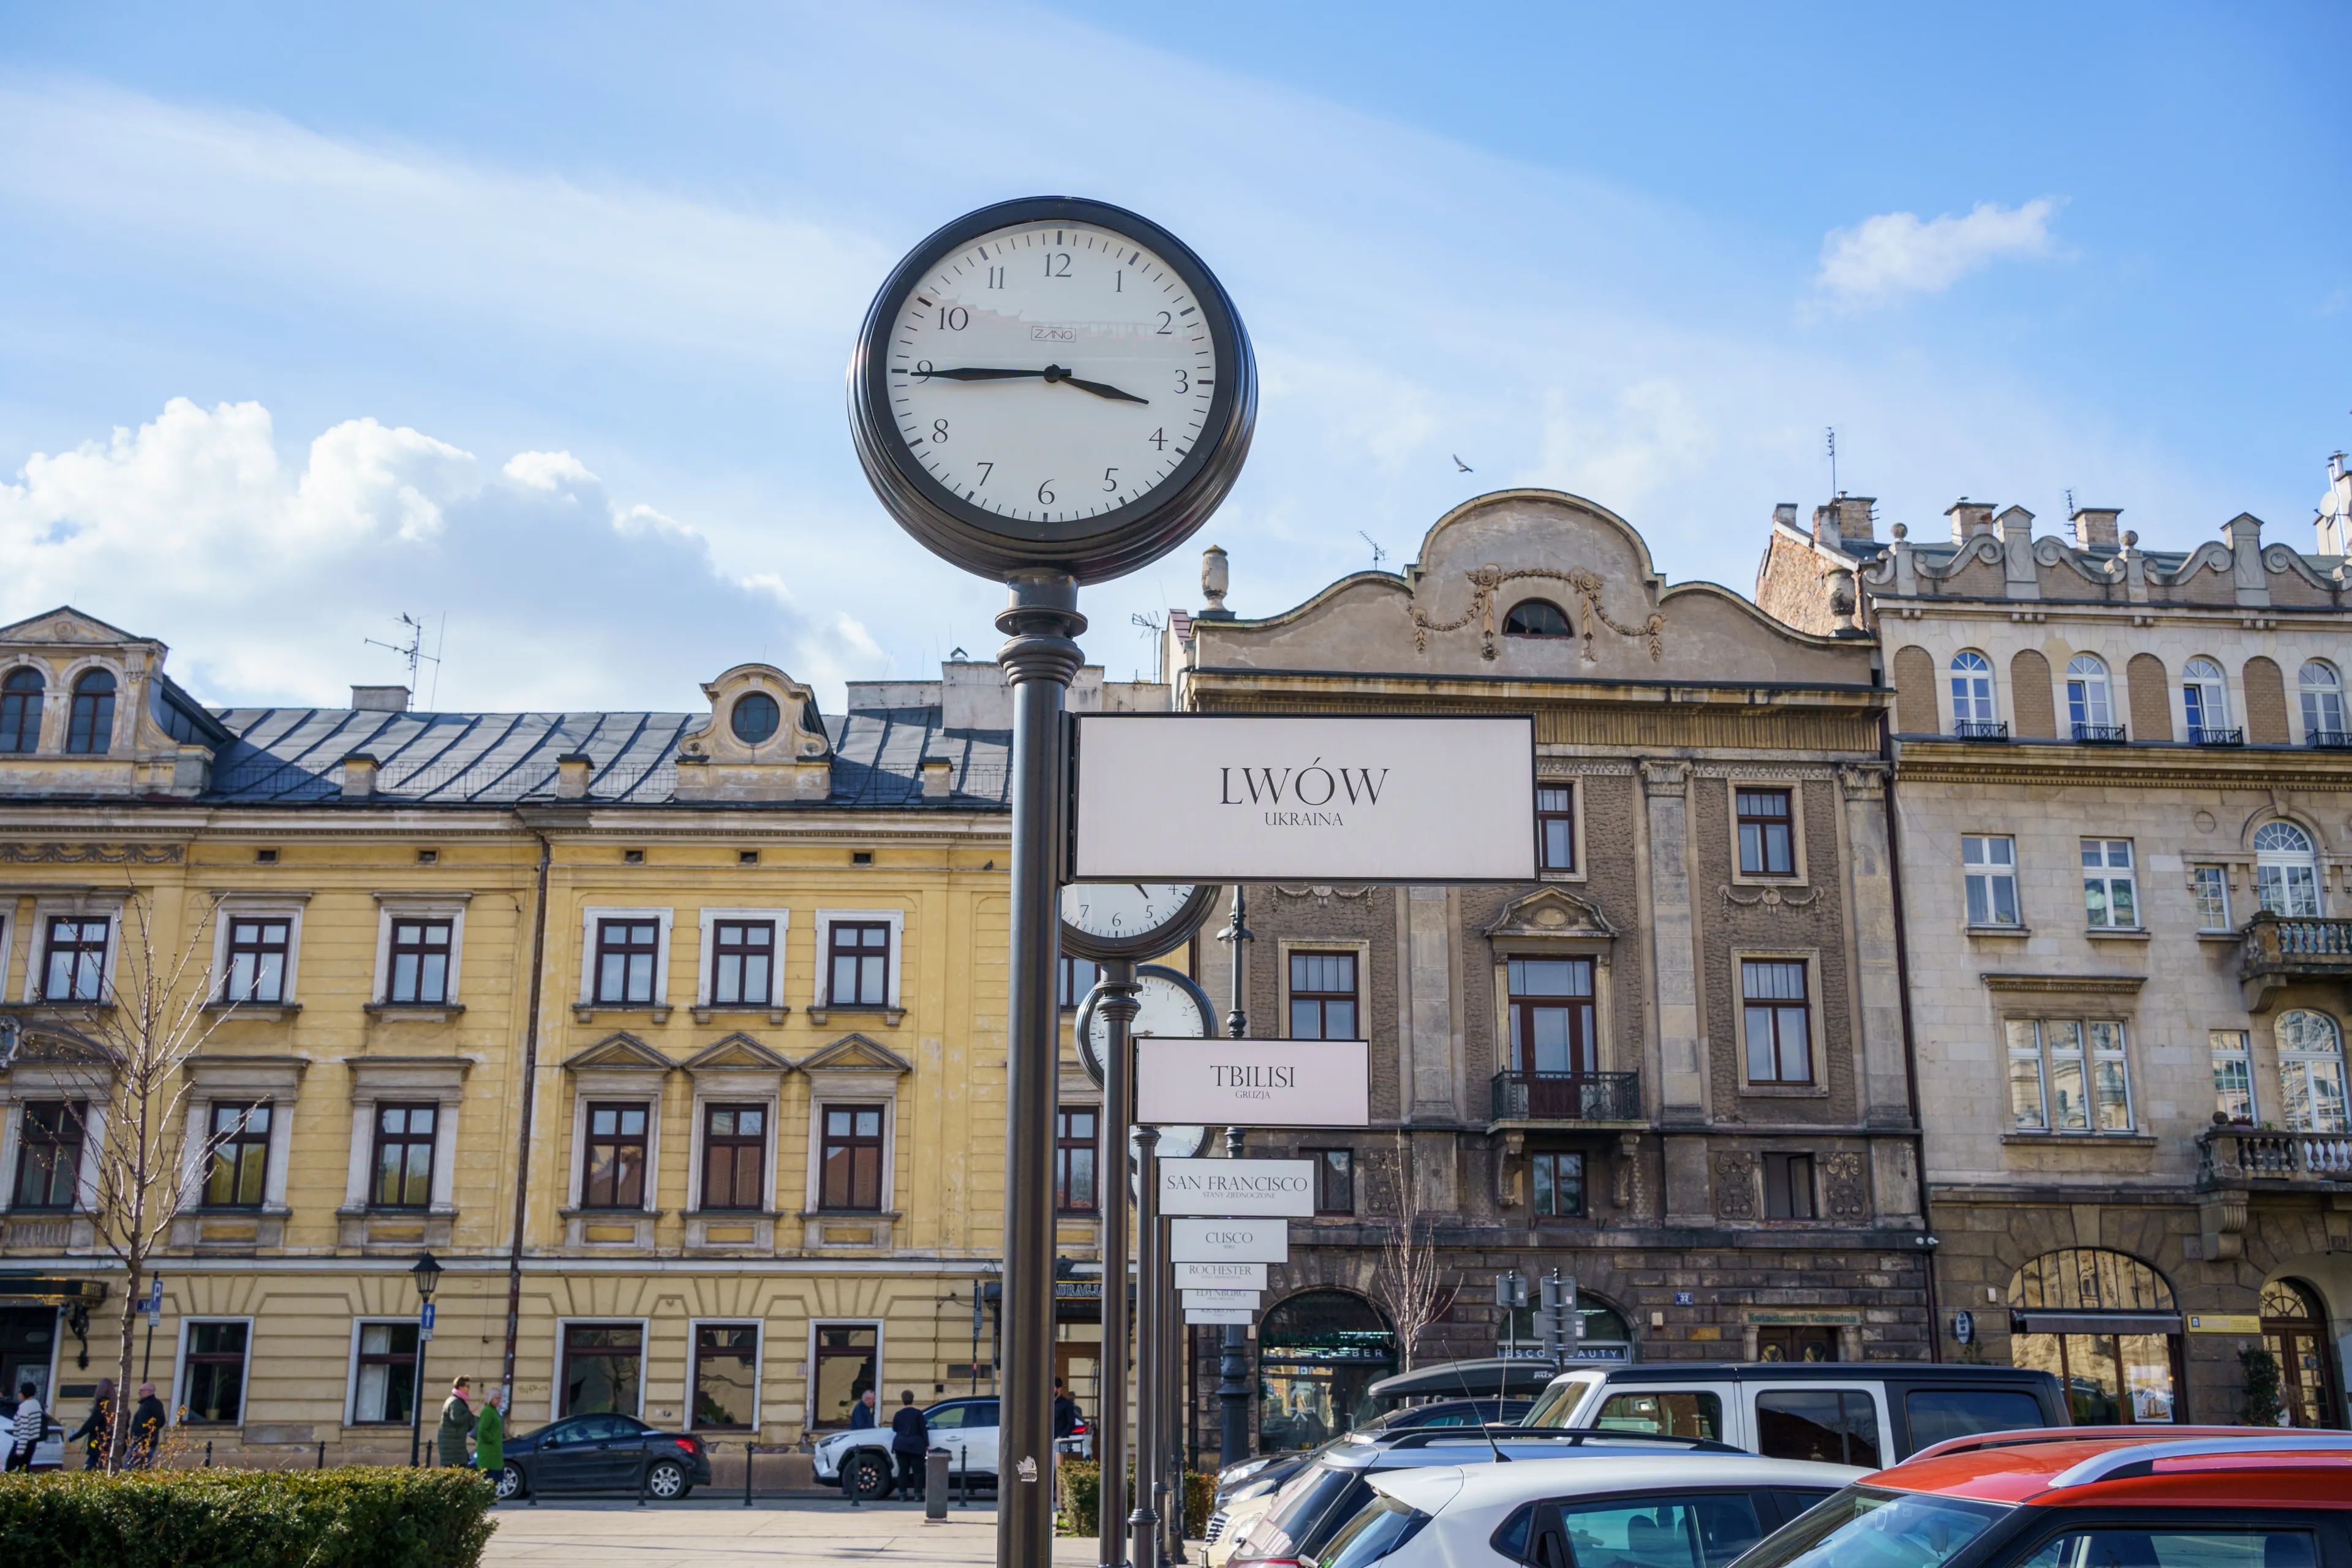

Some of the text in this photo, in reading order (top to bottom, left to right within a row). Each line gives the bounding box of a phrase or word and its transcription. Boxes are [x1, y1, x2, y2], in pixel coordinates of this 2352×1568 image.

[1043, 253, 1072, 277] 12
[987, 266, 1005, 289] 11
[1115, 270, 1123, 293] 1
[938, 306, 969, 331] 10
[1156, 311, 1174, 334] 2
[1034, 329, 1073, 340] ZANO
[916, 360, 933, 384] 9
[1174, 369, 1189, 394] 3
[932, 419, 949, 443] 8
[1148, 427, 1169, 451] 4
[976, 462, 994, 486] 7
[1102, 468, 1120, 492] 5
[1038, 479, 1055, 505] 6
[1219, 757, 1390, 805] LWÓW
[1264, 812, 1344, 826] UKRAINA
[1167, 884, 1178, 895] 4
[1080, 905, 1090, 918] 7
[1112, 911, 1122, 927] 6
[1145, 905, 1154, 919] 5
[1166, 992, 1170, 1001] 1
[1181, 1006, 1188, 1017] 2
[1210, 1064, 1296, 1088] TBILISI
[1235, 1090, 1271, 1100] GRUZJA
[1167, 1175, 1308, 1192] SAN FRANCISCO
[1205, 1232, 1253, 1244] CUSCO
[1189, 1265, 1252, 1276] ROCHESTER
[154, 1283, 162, 1302] P
[1556, 1349, 1618, 1358] AUTY
